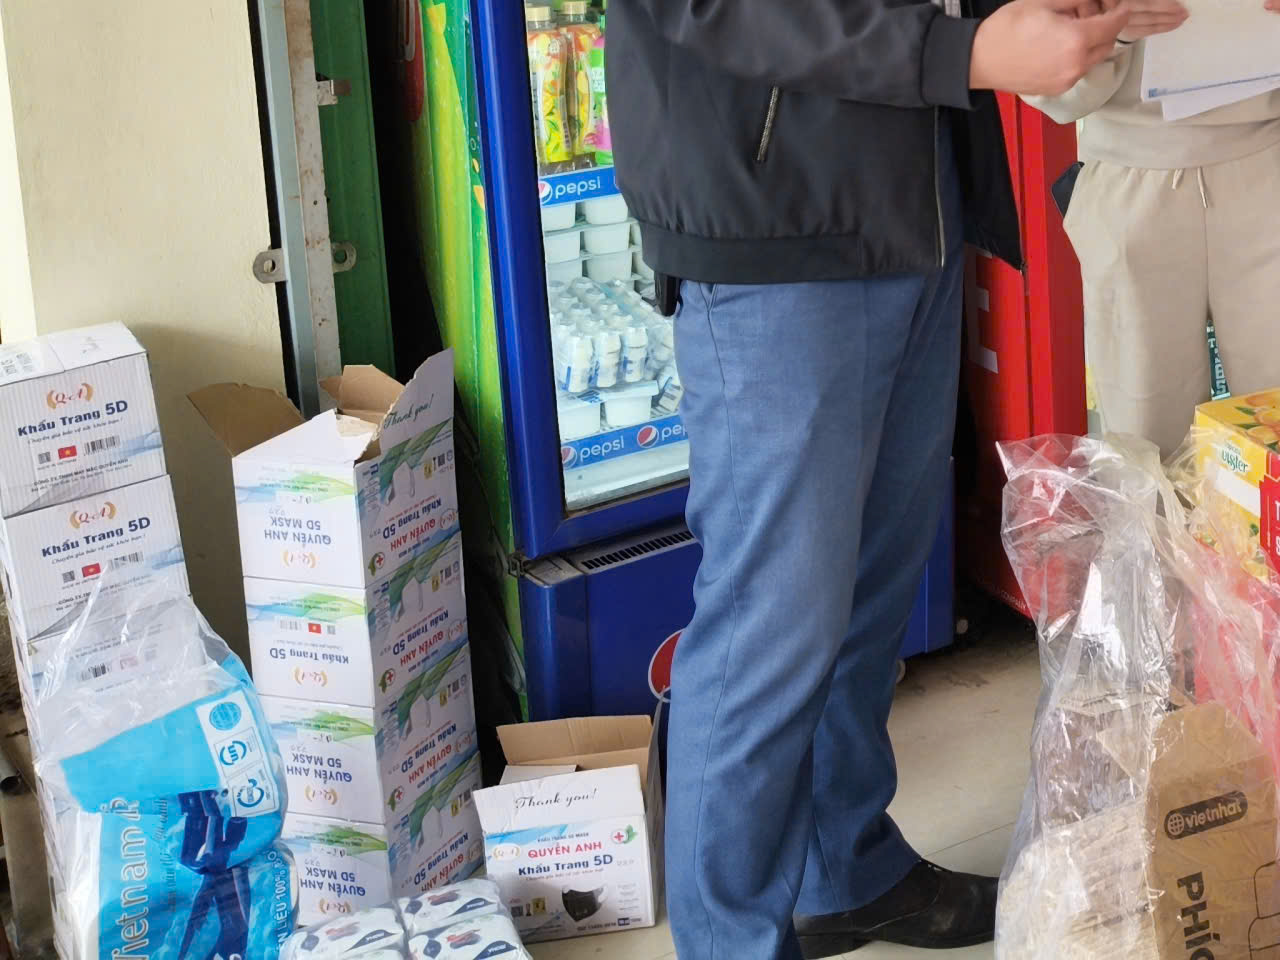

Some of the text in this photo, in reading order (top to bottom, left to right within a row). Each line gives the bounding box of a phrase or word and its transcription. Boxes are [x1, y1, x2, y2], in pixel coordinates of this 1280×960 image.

[555, 176, 601, 199] pepsi
[18, 400, 128, 437] Khẩu Trang 5D
[579, 435, 625, 462] pepsi
[270, 515, 321, 531] 5D MASK
[382, 522, 396, 540] 5D
[42, 516, 151, 558] Khẩu Trang 5D
[264, 529, 289, 541] ANH
[270, 647, 287, 660] 5D
[289, 649, 319, 661] Trang
[392, 639, 406, 655] 5D
[292, 752, 342, 768] 5D MASK
[401, 755, 414, 773] 5D
[286, 764, 313, 778] ANH
[514, 787, 598, 809] Thank you!
[575, 841, 603, 853] ANH
[305, 865, 356, 883] 5D MASK
[518, 863, 551, 877] Khẩu
[555, 860, 589, 873] Trang
[593, 854, 613, 867] 5D
